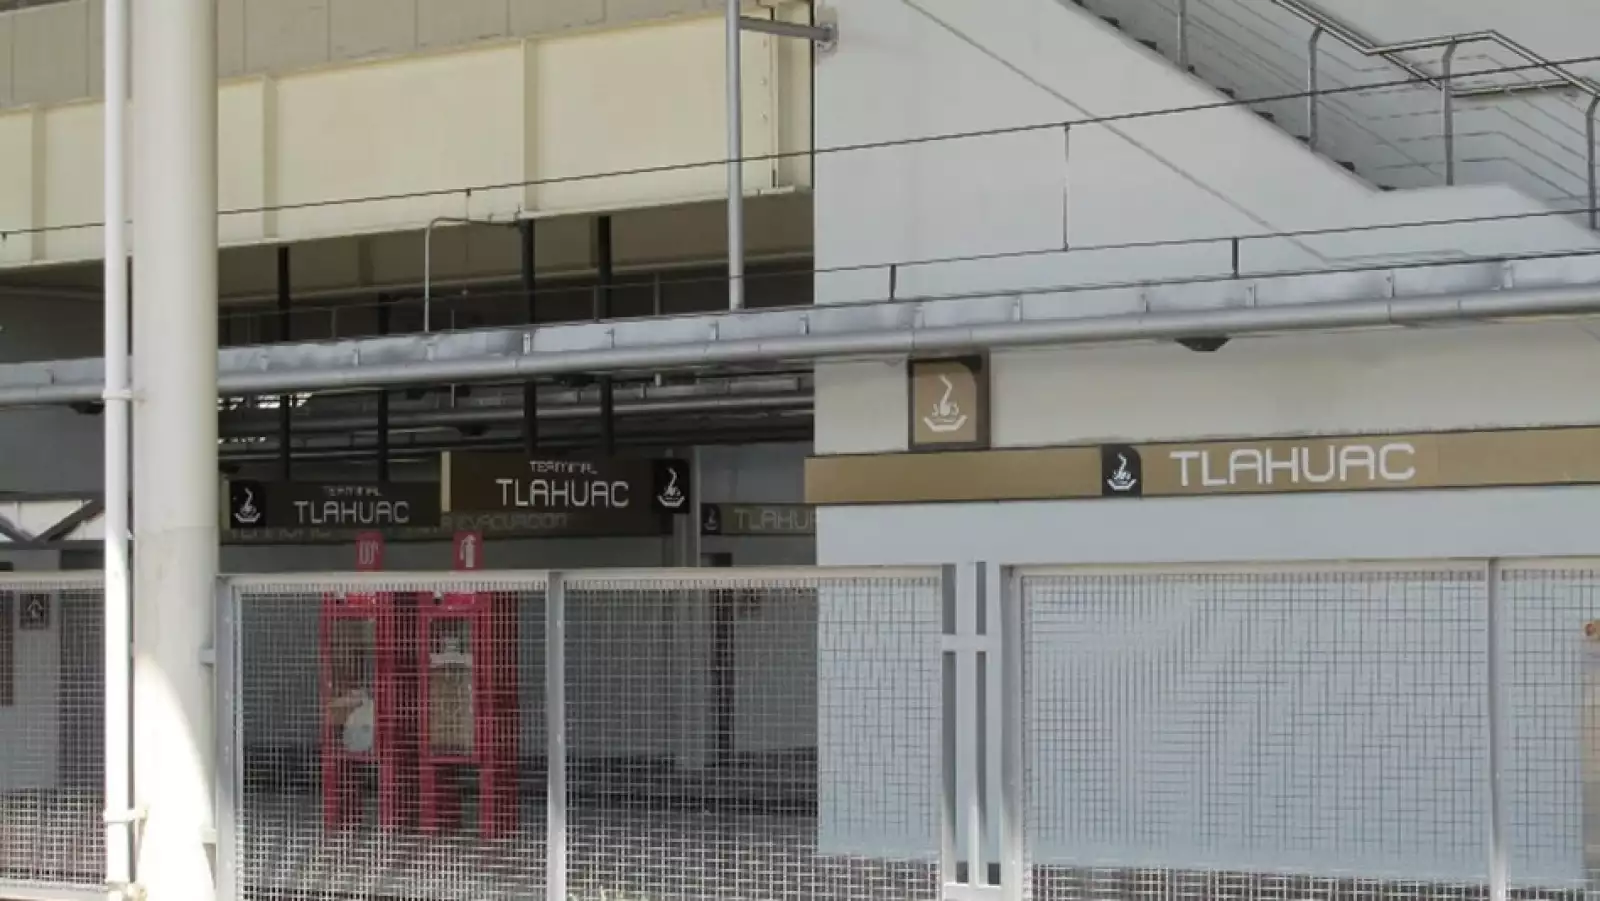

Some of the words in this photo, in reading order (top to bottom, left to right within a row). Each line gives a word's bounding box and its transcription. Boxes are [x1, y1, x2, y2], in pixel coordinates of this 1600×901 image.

[1169, 443, 1415, 486] TLAHUAC
[495, 478, 629, 508] TLAHUAC
[293, 500, 409, 524] TLAHUAC
[733, 507, 814, 532] TLAHU
